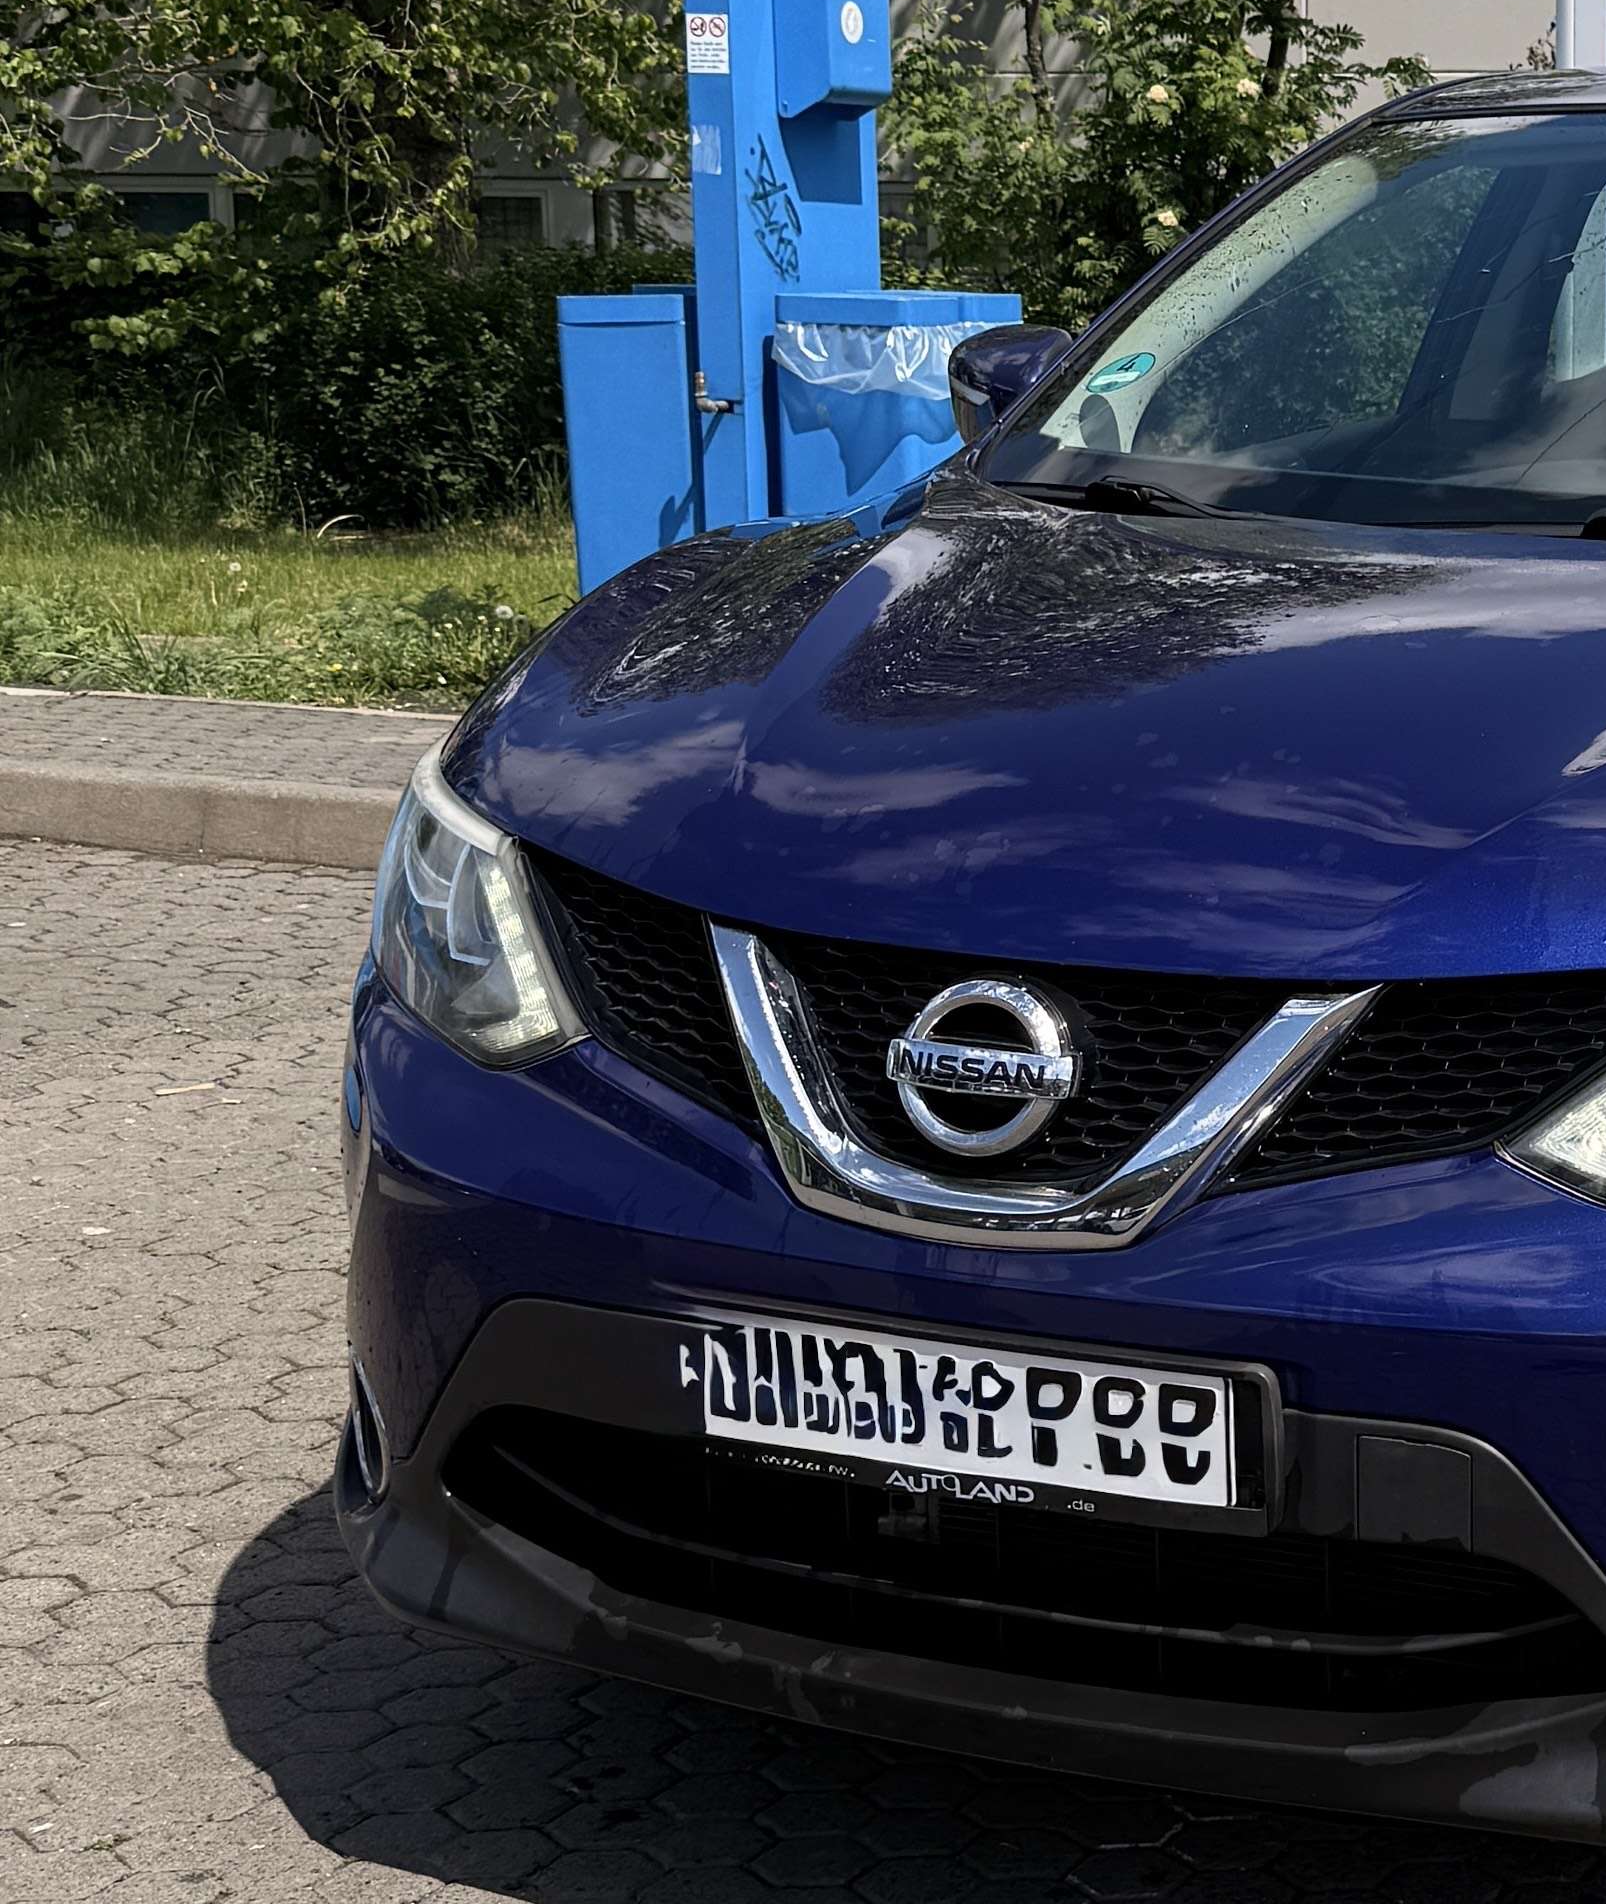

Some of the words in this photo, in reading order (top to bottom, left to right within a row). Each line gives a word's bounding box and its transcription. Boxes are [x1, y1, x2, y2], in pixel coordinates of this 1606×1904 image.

[901, 1048, 1045, 1090] NISSAN
[886, 1470, 1034, 1504] AUTOLAND
[1067, 1499, 1095, 1512] .de
